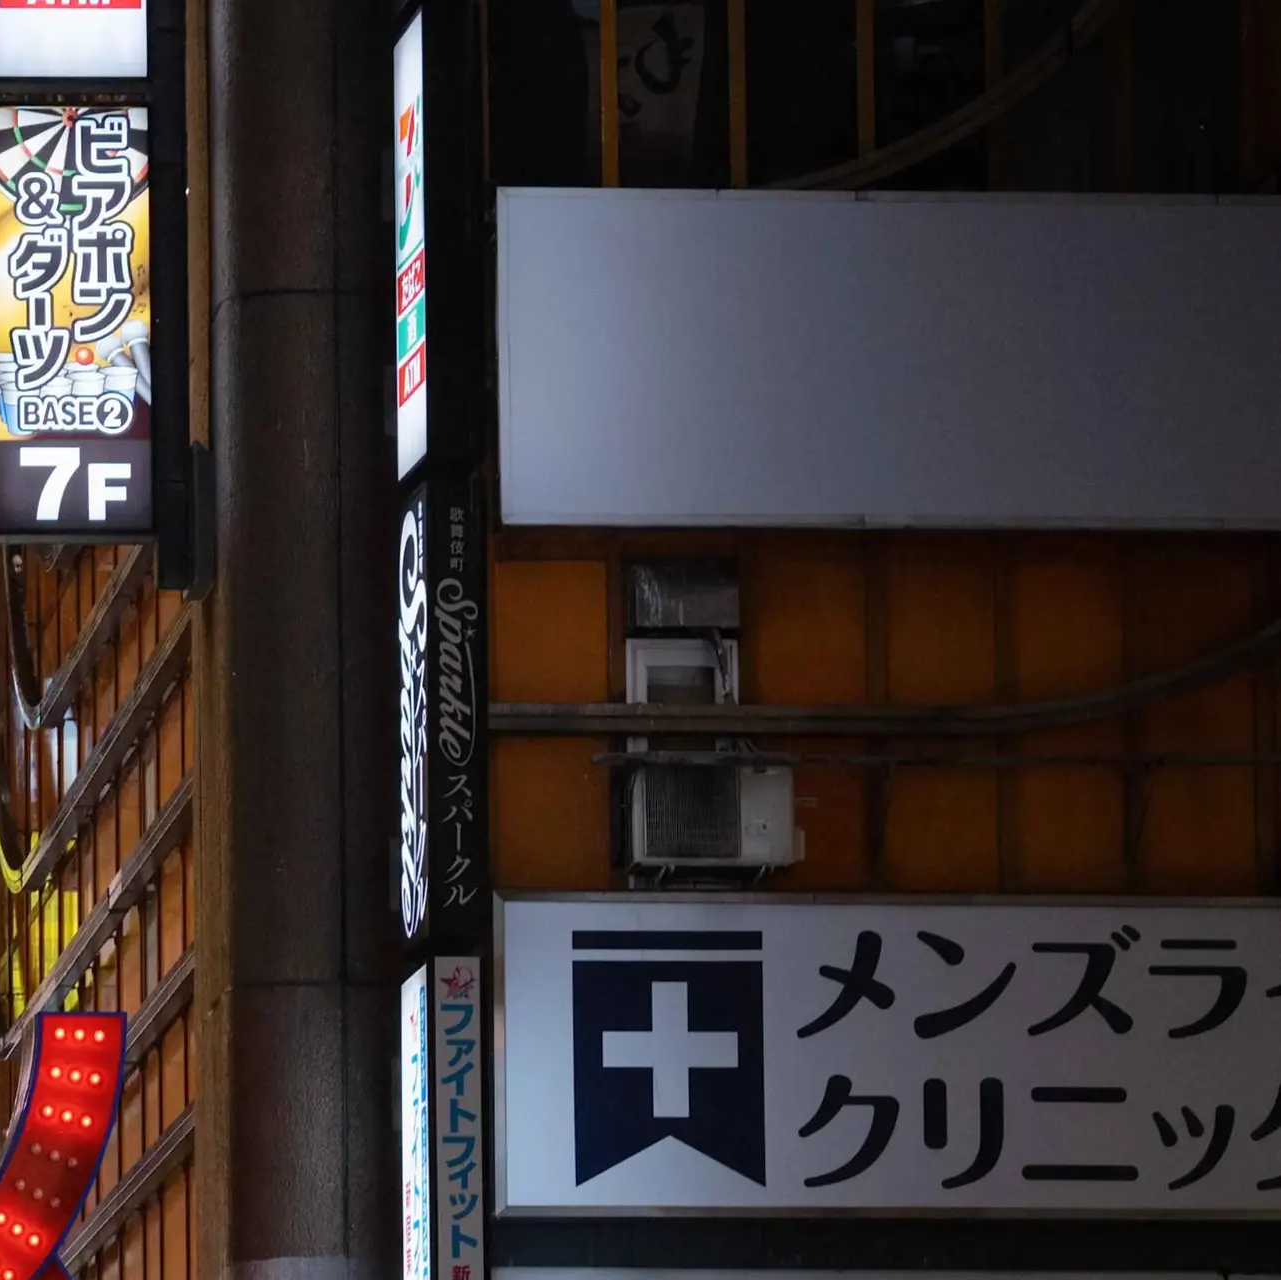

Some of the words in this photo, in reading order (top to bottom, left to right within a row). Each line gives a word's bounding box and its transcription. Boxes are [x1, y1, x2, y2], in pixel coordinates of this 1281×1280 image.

[75, 116, 131, 342] ビアポン
[20, 447, 131, 521] 7F
[436, 577, 478, 768] Sparkle
[442, 775, 478, 907] スパークル
[796, 923, 1281, 1040] メンズラ
[440, 1003, 479, 1260] ファイトフィット
